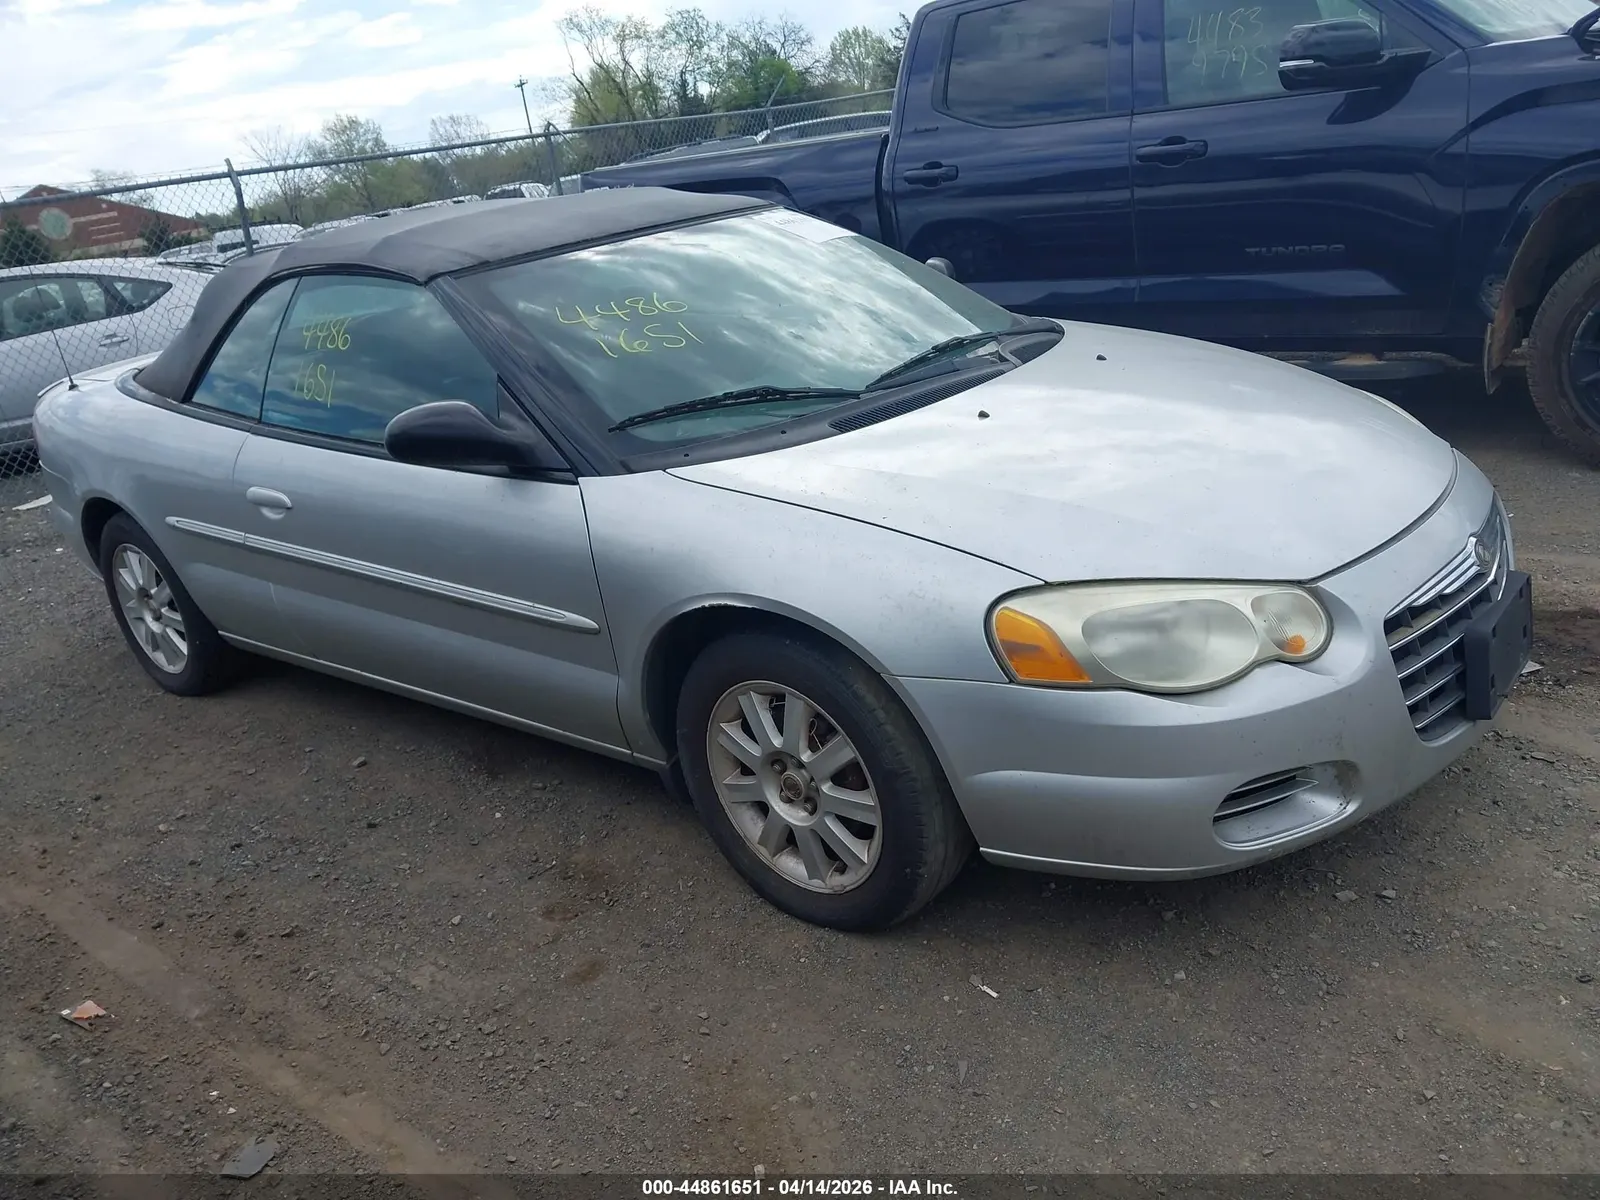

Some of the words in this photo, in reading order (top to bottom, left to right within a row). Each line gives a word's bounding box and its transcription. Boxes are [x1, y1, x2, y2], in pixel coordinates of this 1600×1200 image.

[1244, 244, 1346, 257] TUNDRA
[555, 292, 688, 331] 4486
[302, 317, 352, 350] 4486
